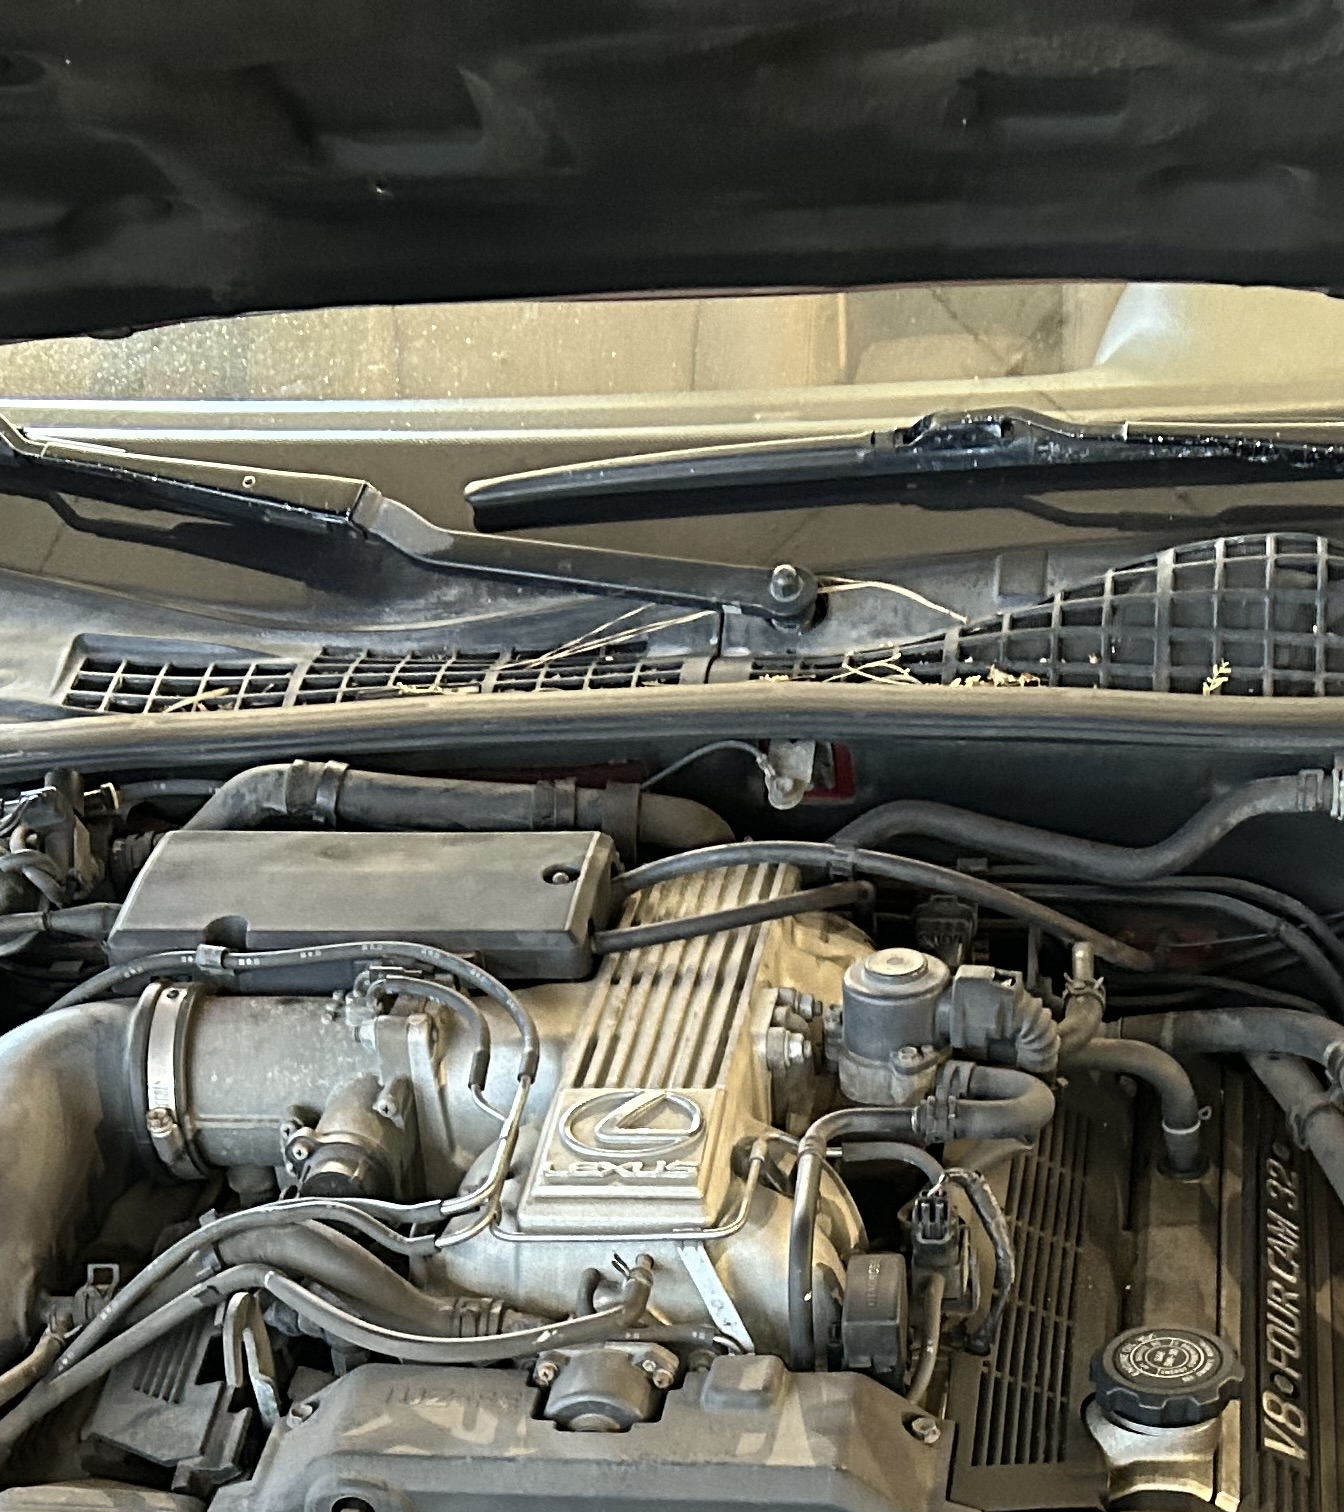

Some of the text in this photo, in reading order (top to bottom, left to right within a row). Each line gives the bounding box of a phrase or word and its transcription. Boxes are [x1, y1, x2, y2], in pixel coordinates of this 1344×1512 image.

[542, 1160, 700, 1178] LEXUS
[1262, 1157, 1308, 1461] V8 FOUR CAM 32
